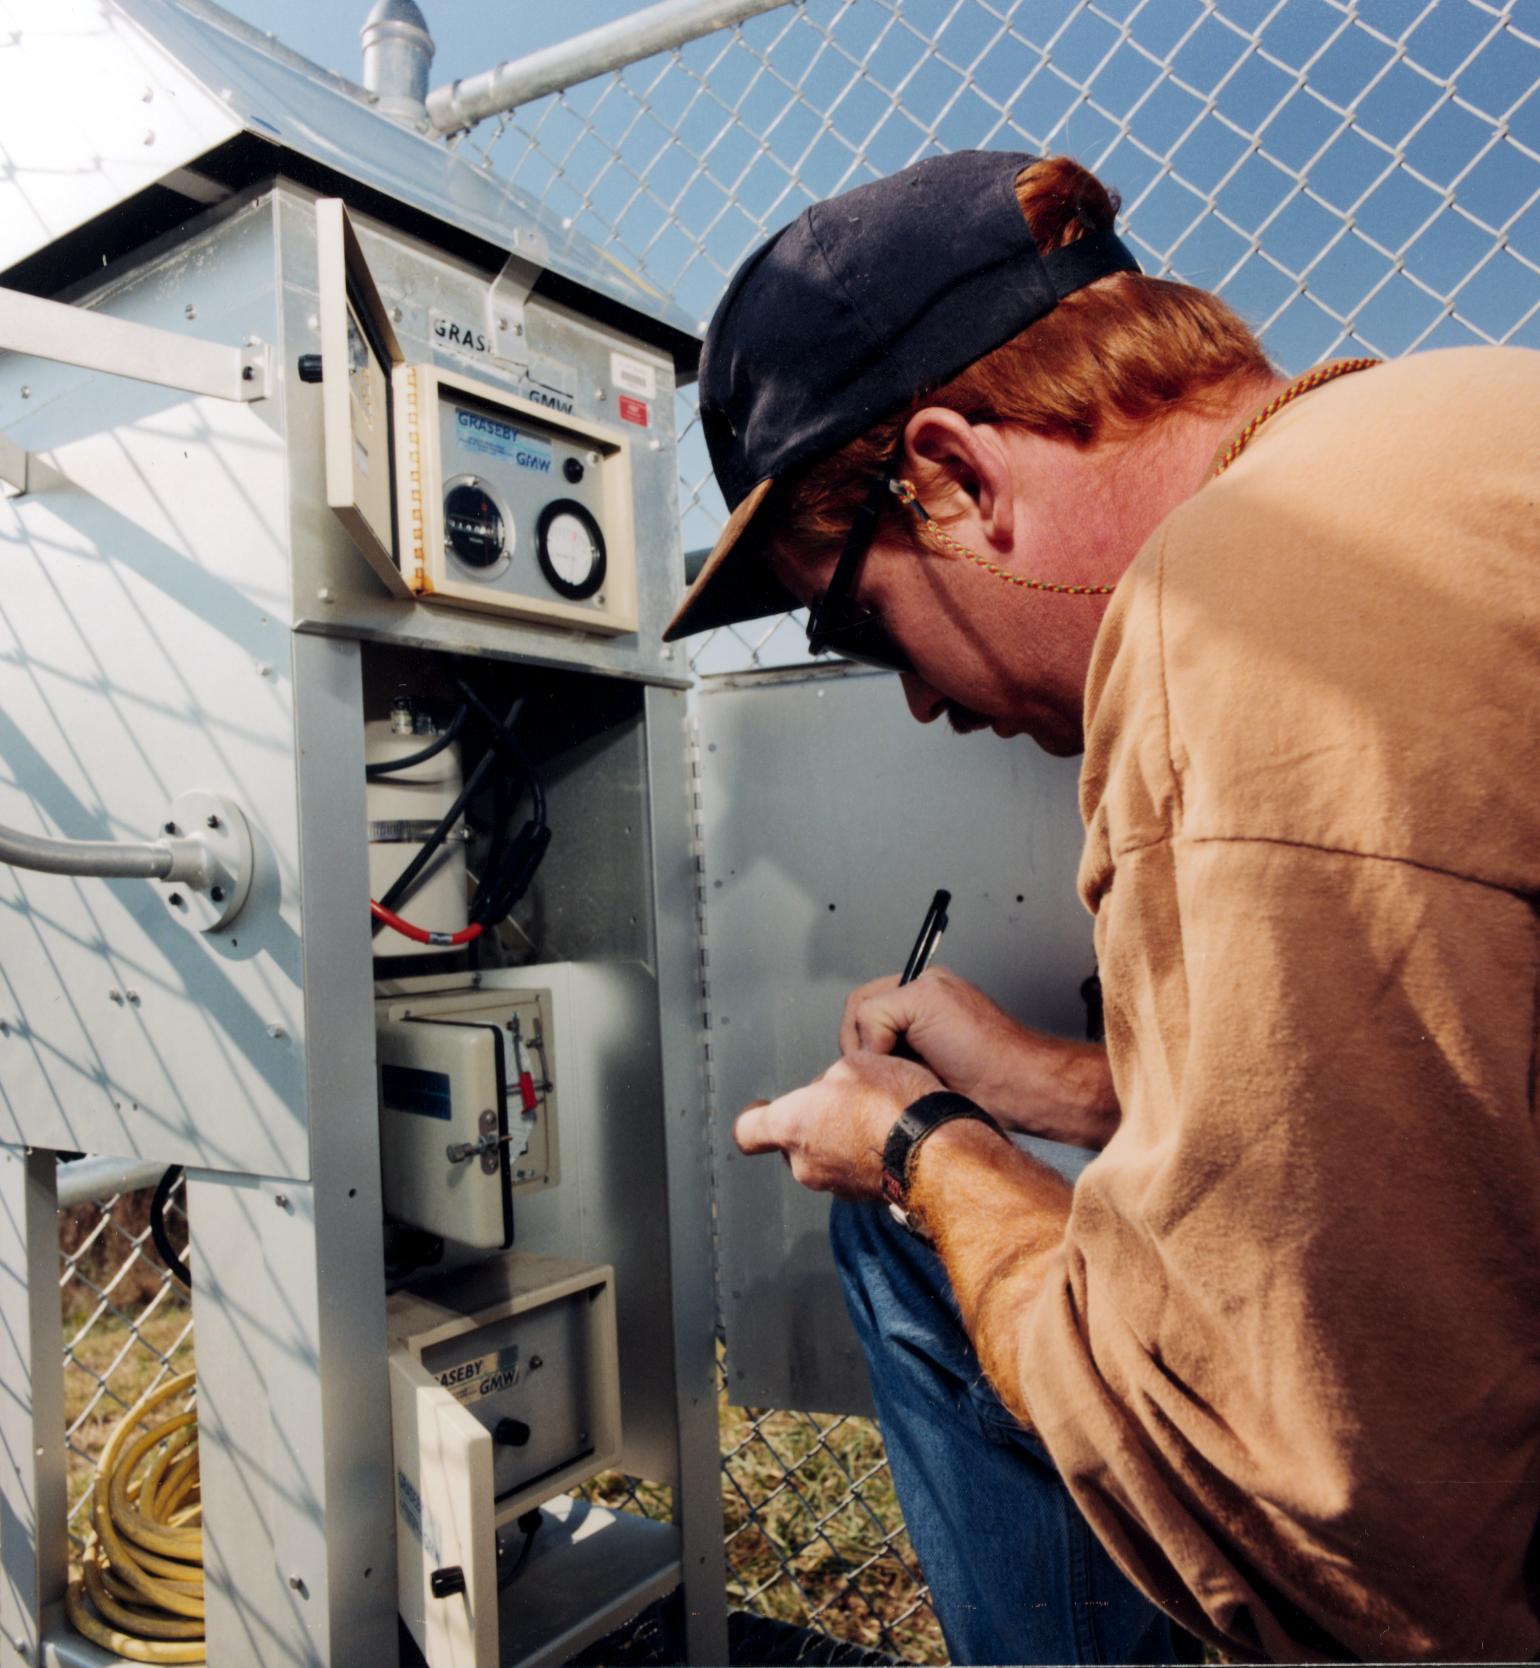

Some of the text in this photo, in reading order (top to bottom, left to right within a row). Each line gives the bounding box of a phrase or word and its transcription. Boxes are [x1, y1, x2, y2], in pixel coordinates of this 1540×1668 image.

[528, 390, 574, 414] GMW
[458, 412, 519, 442] GRASEBY
[516, 452, 551, 473] GMW
[479, 1369, 516, 1395] GMW
